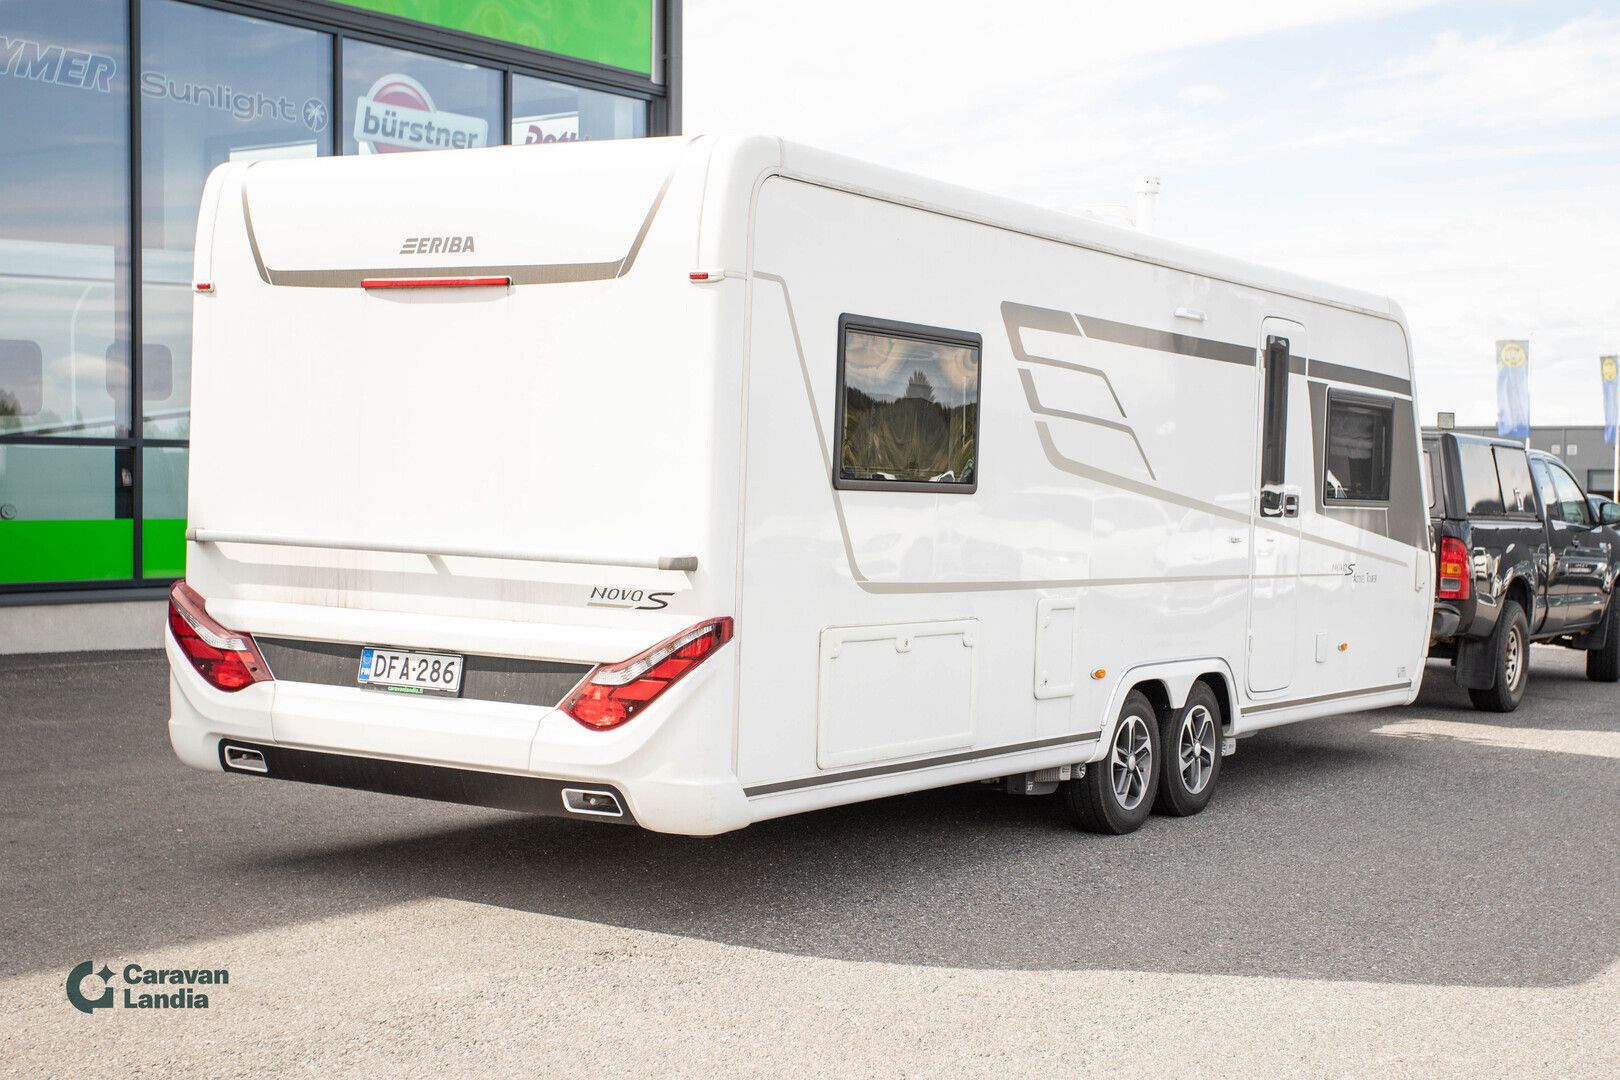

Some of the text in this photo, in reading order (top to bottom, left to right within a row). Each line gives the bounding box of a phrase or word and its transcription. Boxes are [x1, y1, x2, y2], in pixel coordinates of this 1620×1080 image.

[141, 71, 297, 121] Sunlight
[363, 106, 478, 149] bürstner
[400, 236, 475, 254] ERIBA
[373, 654, 455, 684] DFA-286
